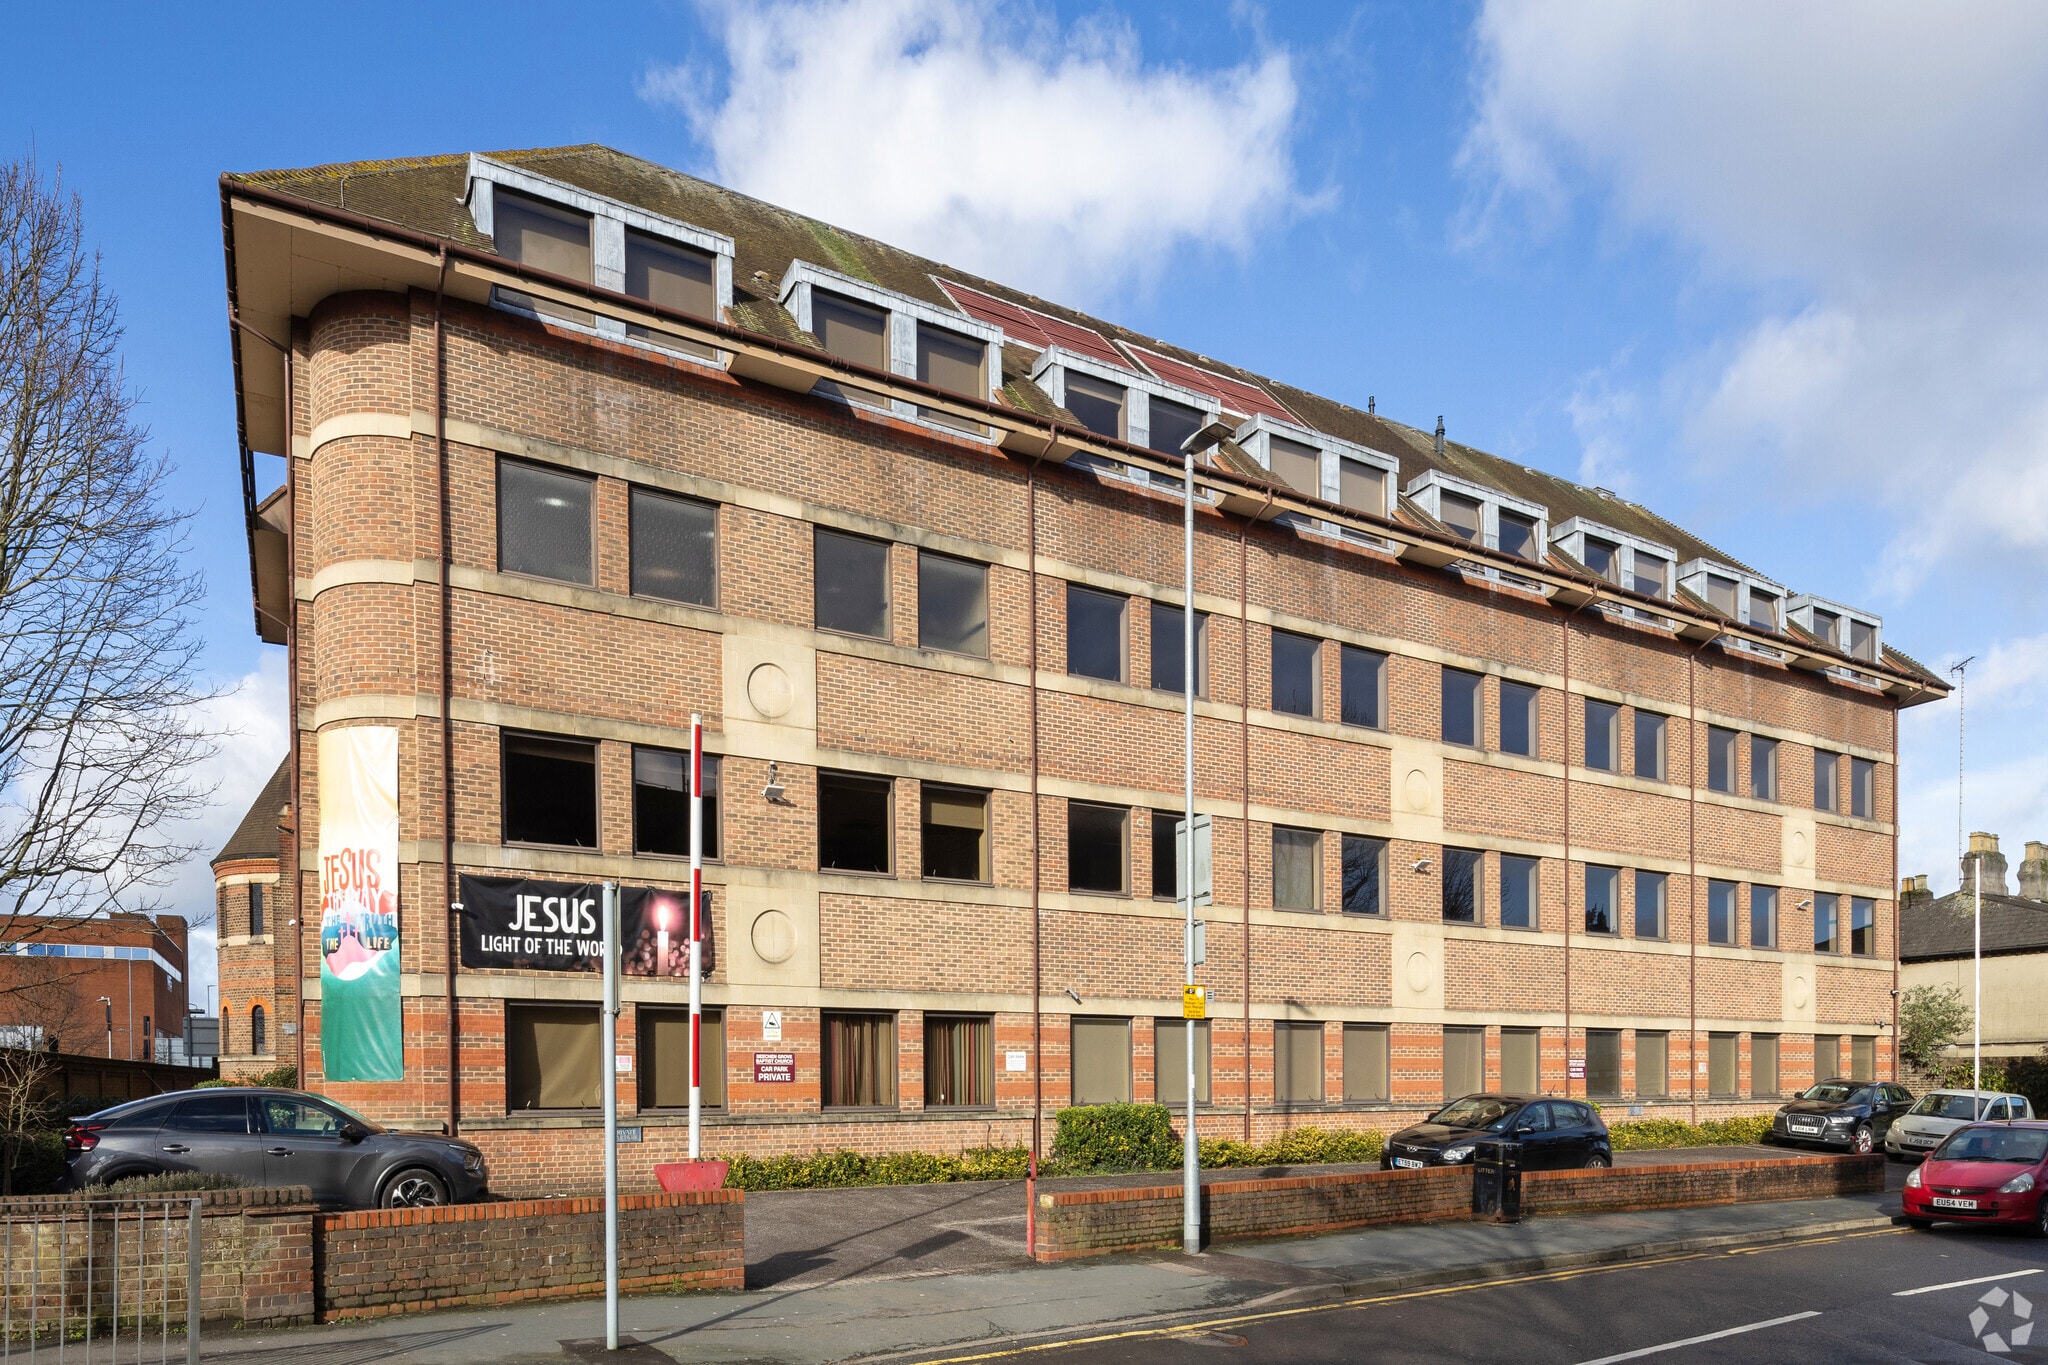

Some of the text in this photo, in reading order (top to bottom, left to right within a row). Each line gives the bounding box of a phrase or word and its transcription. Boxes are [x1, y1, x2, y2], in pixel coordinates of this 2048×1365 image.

[324, 847, 381, 895] JESUS
[508, 894, 596, 935] JESUS
[325, 936, 391, 951] THE LIFE
[481, 934, 521, 953] LIGHT
[524, 937, 542, 954] OF
[545, 938, 573, 956] THE
[758, 1073, 791, 1081] PRIVATE
[1936, 1198, 1974, 1208] EU54 VEM
